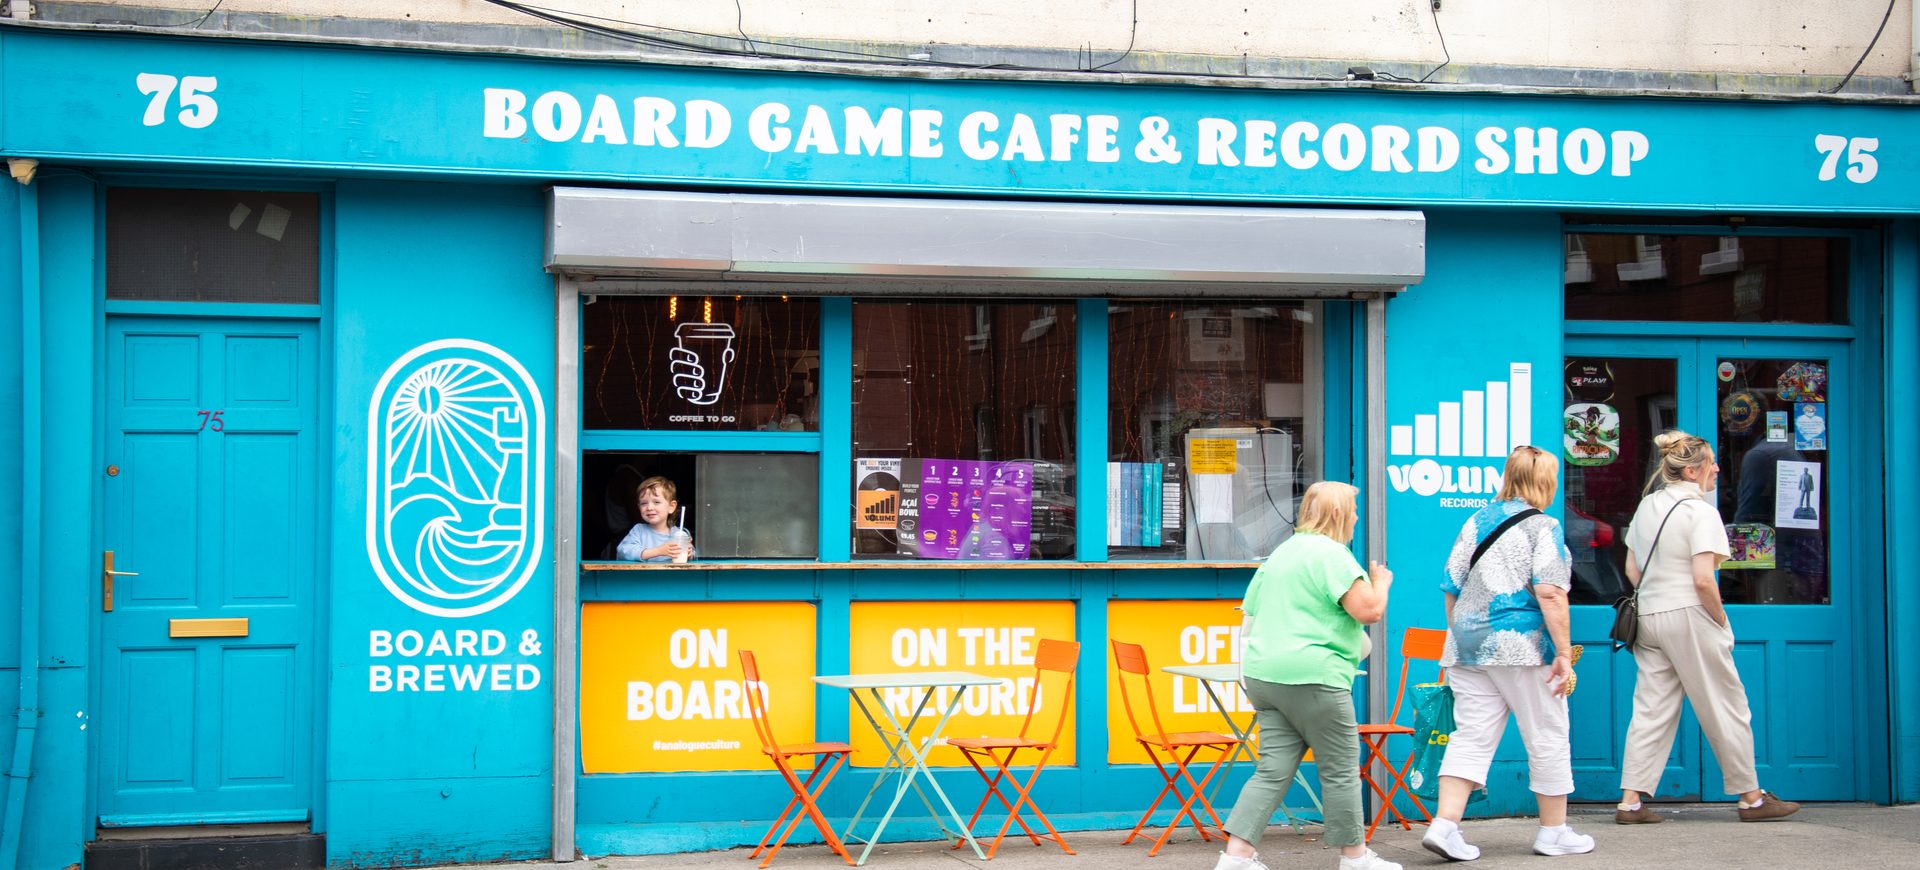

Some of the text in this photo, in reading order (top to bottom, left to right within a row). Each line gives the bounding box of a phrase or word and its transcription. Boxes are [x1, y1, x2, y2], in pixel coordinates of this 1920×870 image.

[136, 72, 218, 129] 75
[483, 87, 1649, 177] BOARD GAME CAFE & RECORD SHOP
[1815, 133, 1879, 184] 75
[197, 410, 225, 432] 75
[930, 465, 936, 475] 1
[952, 466, 958, 476] 2
[974, 467, 980, 477] 3
[995, 468, 1002, 478] 4
[1018, 469, 1024, 479] 5
[1386, 459, 1505, 497] VOLUM
[899, 508, 919, 517] BOWL
[1440, 498, 1488, 508] RECORDS
[865, 514, 895, 522] VOLUME
[369, 629, 542, 657] BOARD &
[669, 628, 728, 669] ON
[891, 627, 1035, 667] ON THE
[369, 664, 541, 692] BREWED
[627, 680, 769, 720] BOARD
[885, 677, 1042, 717] RECORD
[652, 739, 741, 752] #analogueculture
